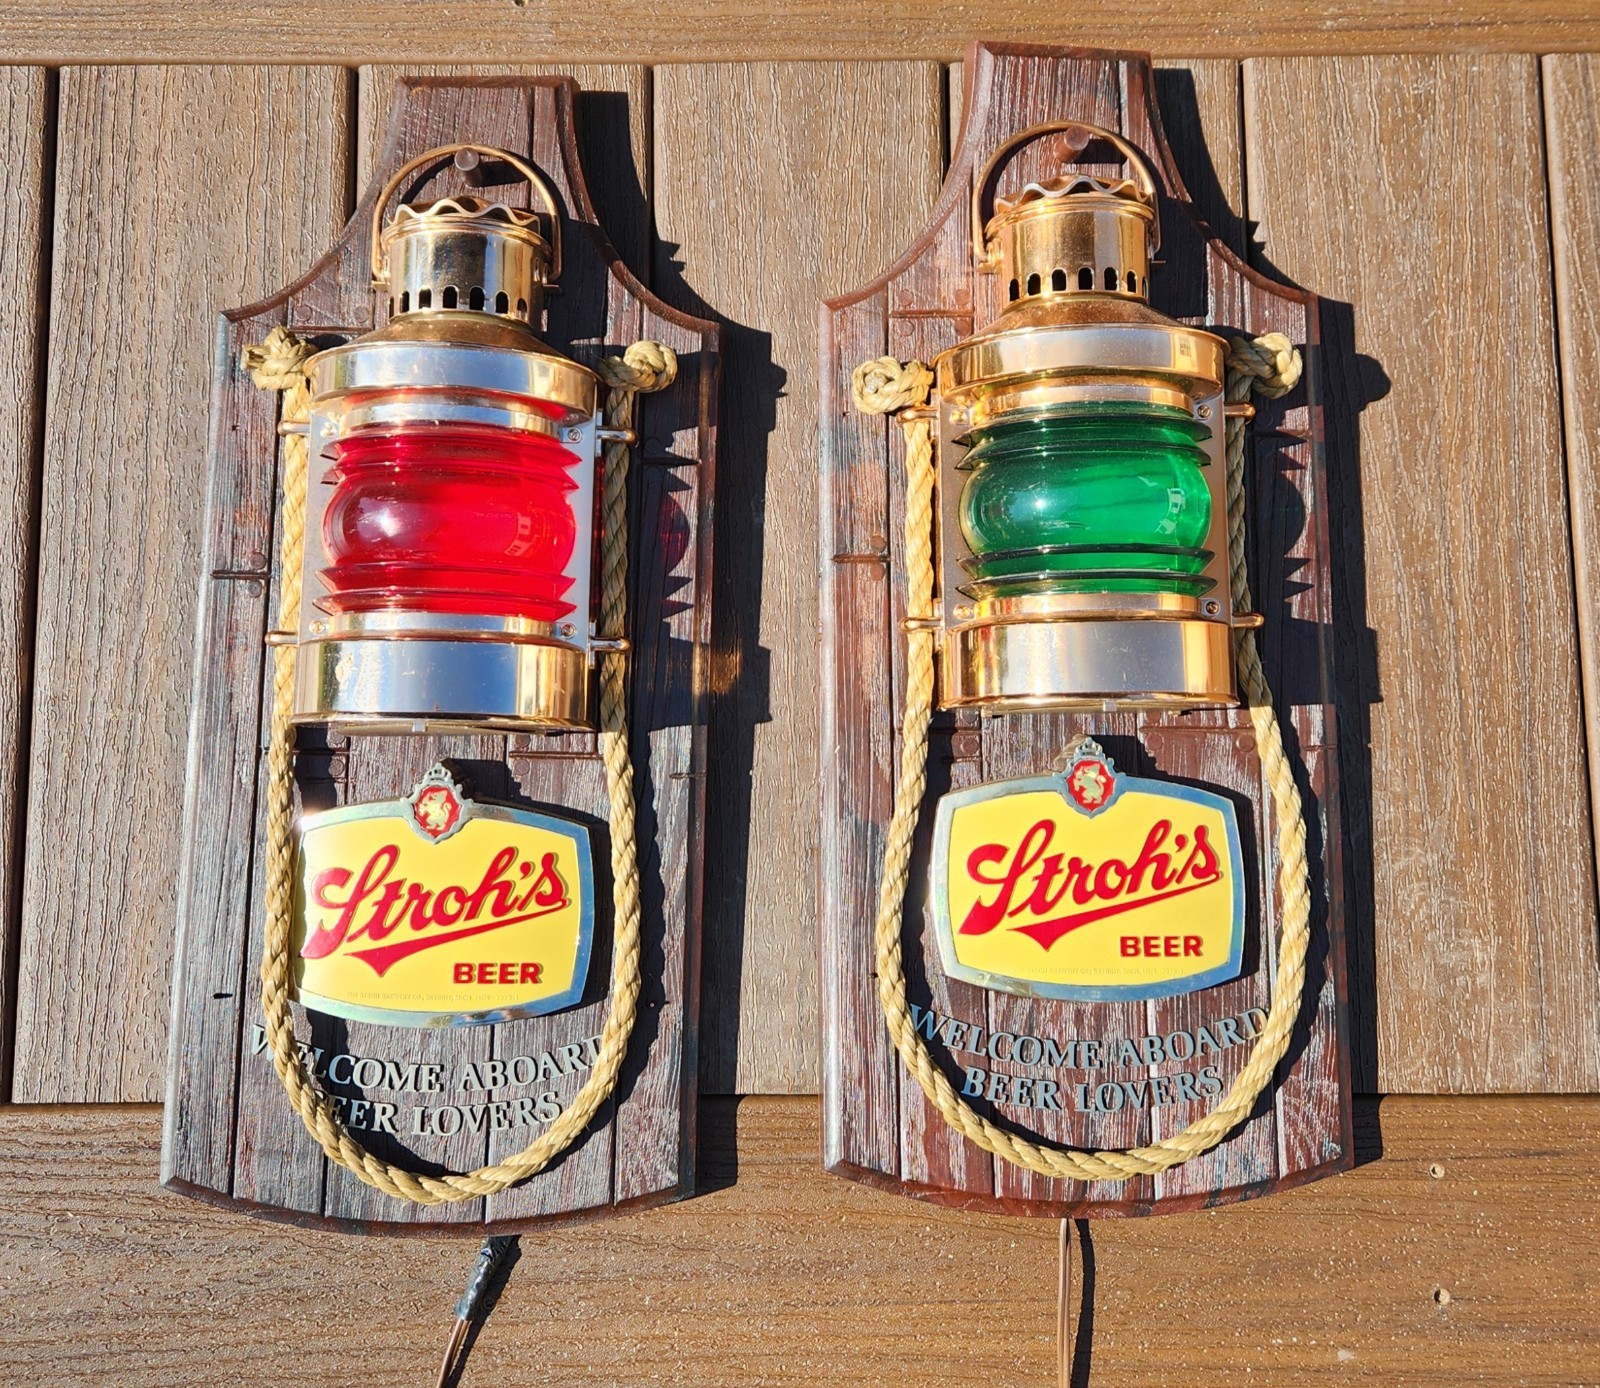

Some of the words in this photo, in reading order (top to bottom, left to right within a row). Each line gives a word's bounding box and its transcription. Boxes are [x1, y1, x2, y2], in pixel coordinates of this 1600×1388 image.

[300, 844, 570, 960] Stroh's
[959, 819, 1222, 936] Stroh's
[1119, 936, 1203, 957] BEER
[453, 962, 542, 985] BEER
[910, 1003, 1102, 1070] WELCOME
[1117, 1007, 1268, 1069] ABOARD
[313, 1089, 398, 1134] EER
[411, 1091, 562, 1137] LOVERS
[960, 1065, 1062, 1111] BEER
[1074, 1066, 1222, 1114] LOVERS
